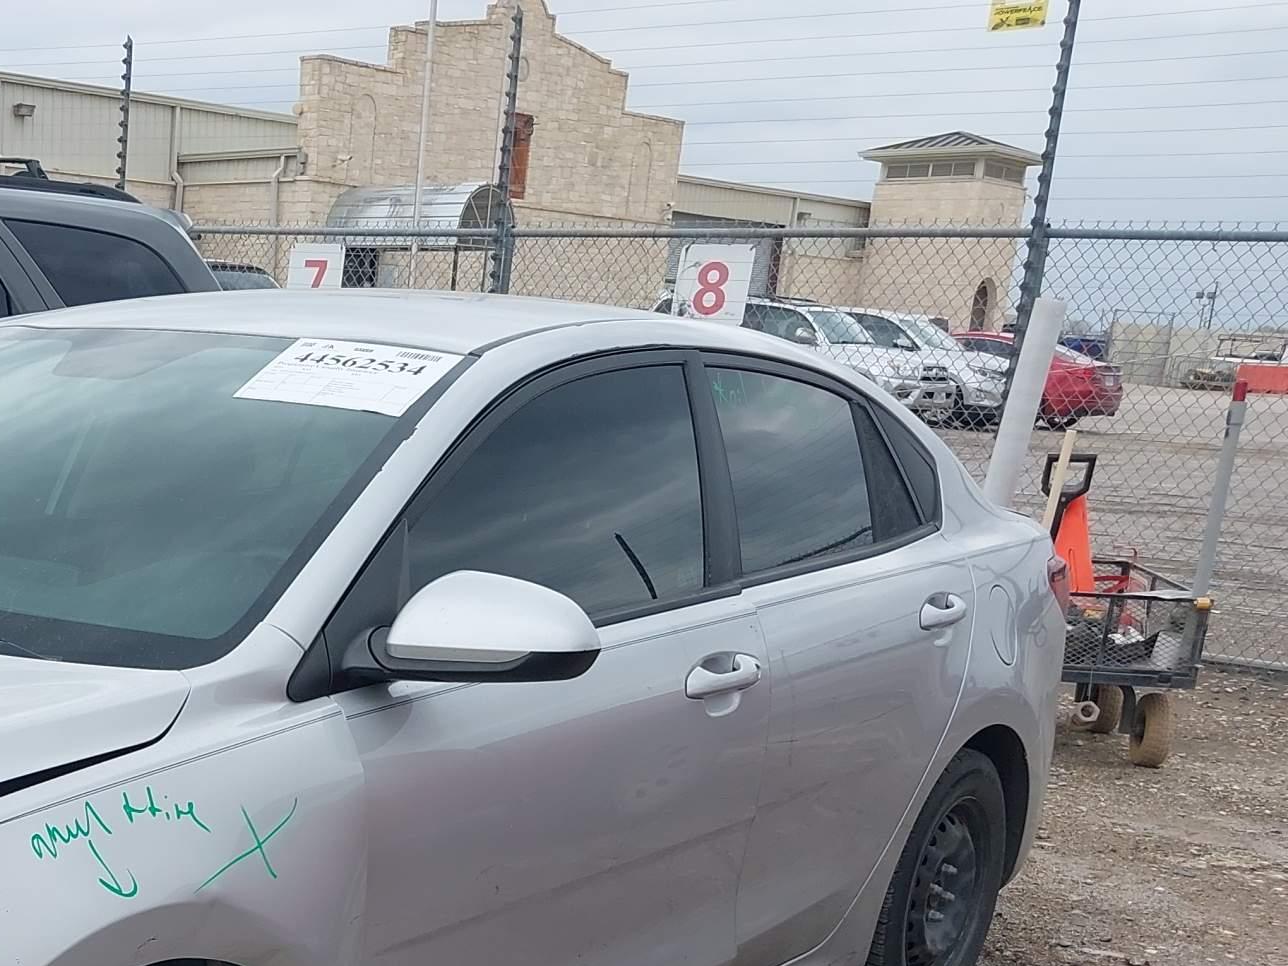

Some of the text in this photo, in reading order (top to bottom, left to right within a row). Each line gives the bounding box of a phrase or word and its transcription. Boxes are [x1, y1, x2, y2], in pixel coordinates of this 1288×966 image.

[304, 259, 329, 289] 7
[692, 261, 730, 316] 8
[293, 351, 428, 376] 44562534
